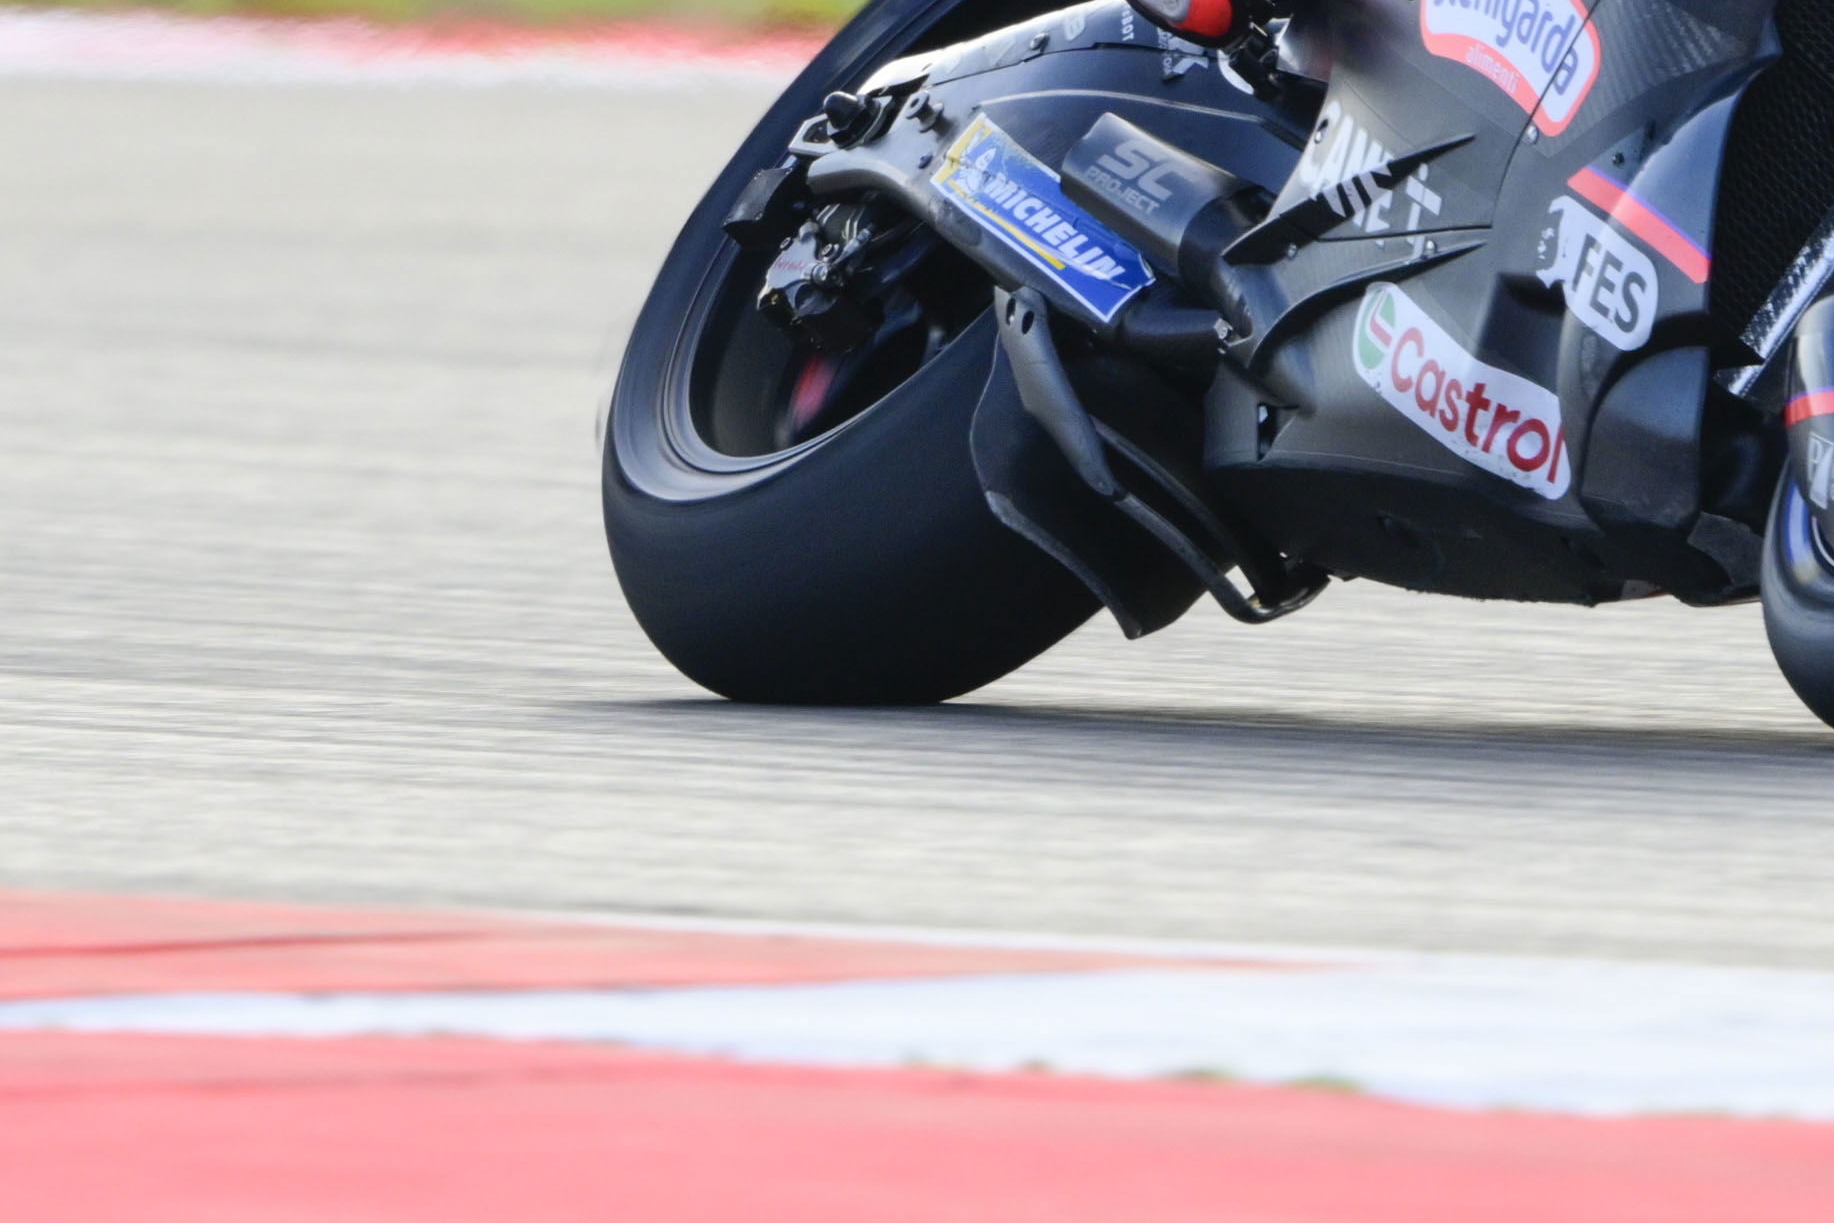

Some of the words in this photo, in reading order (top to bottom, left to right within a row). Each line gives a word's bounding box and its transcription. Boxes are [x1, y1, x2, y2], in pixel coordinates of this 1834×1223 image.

[1084, 165, 1159, 215] PROJECT
[1097, 139, 1176, 202] SC
[983, 172, 1126, 282] MICHELIN
[1391, 326, 1565, 483] Castrol
